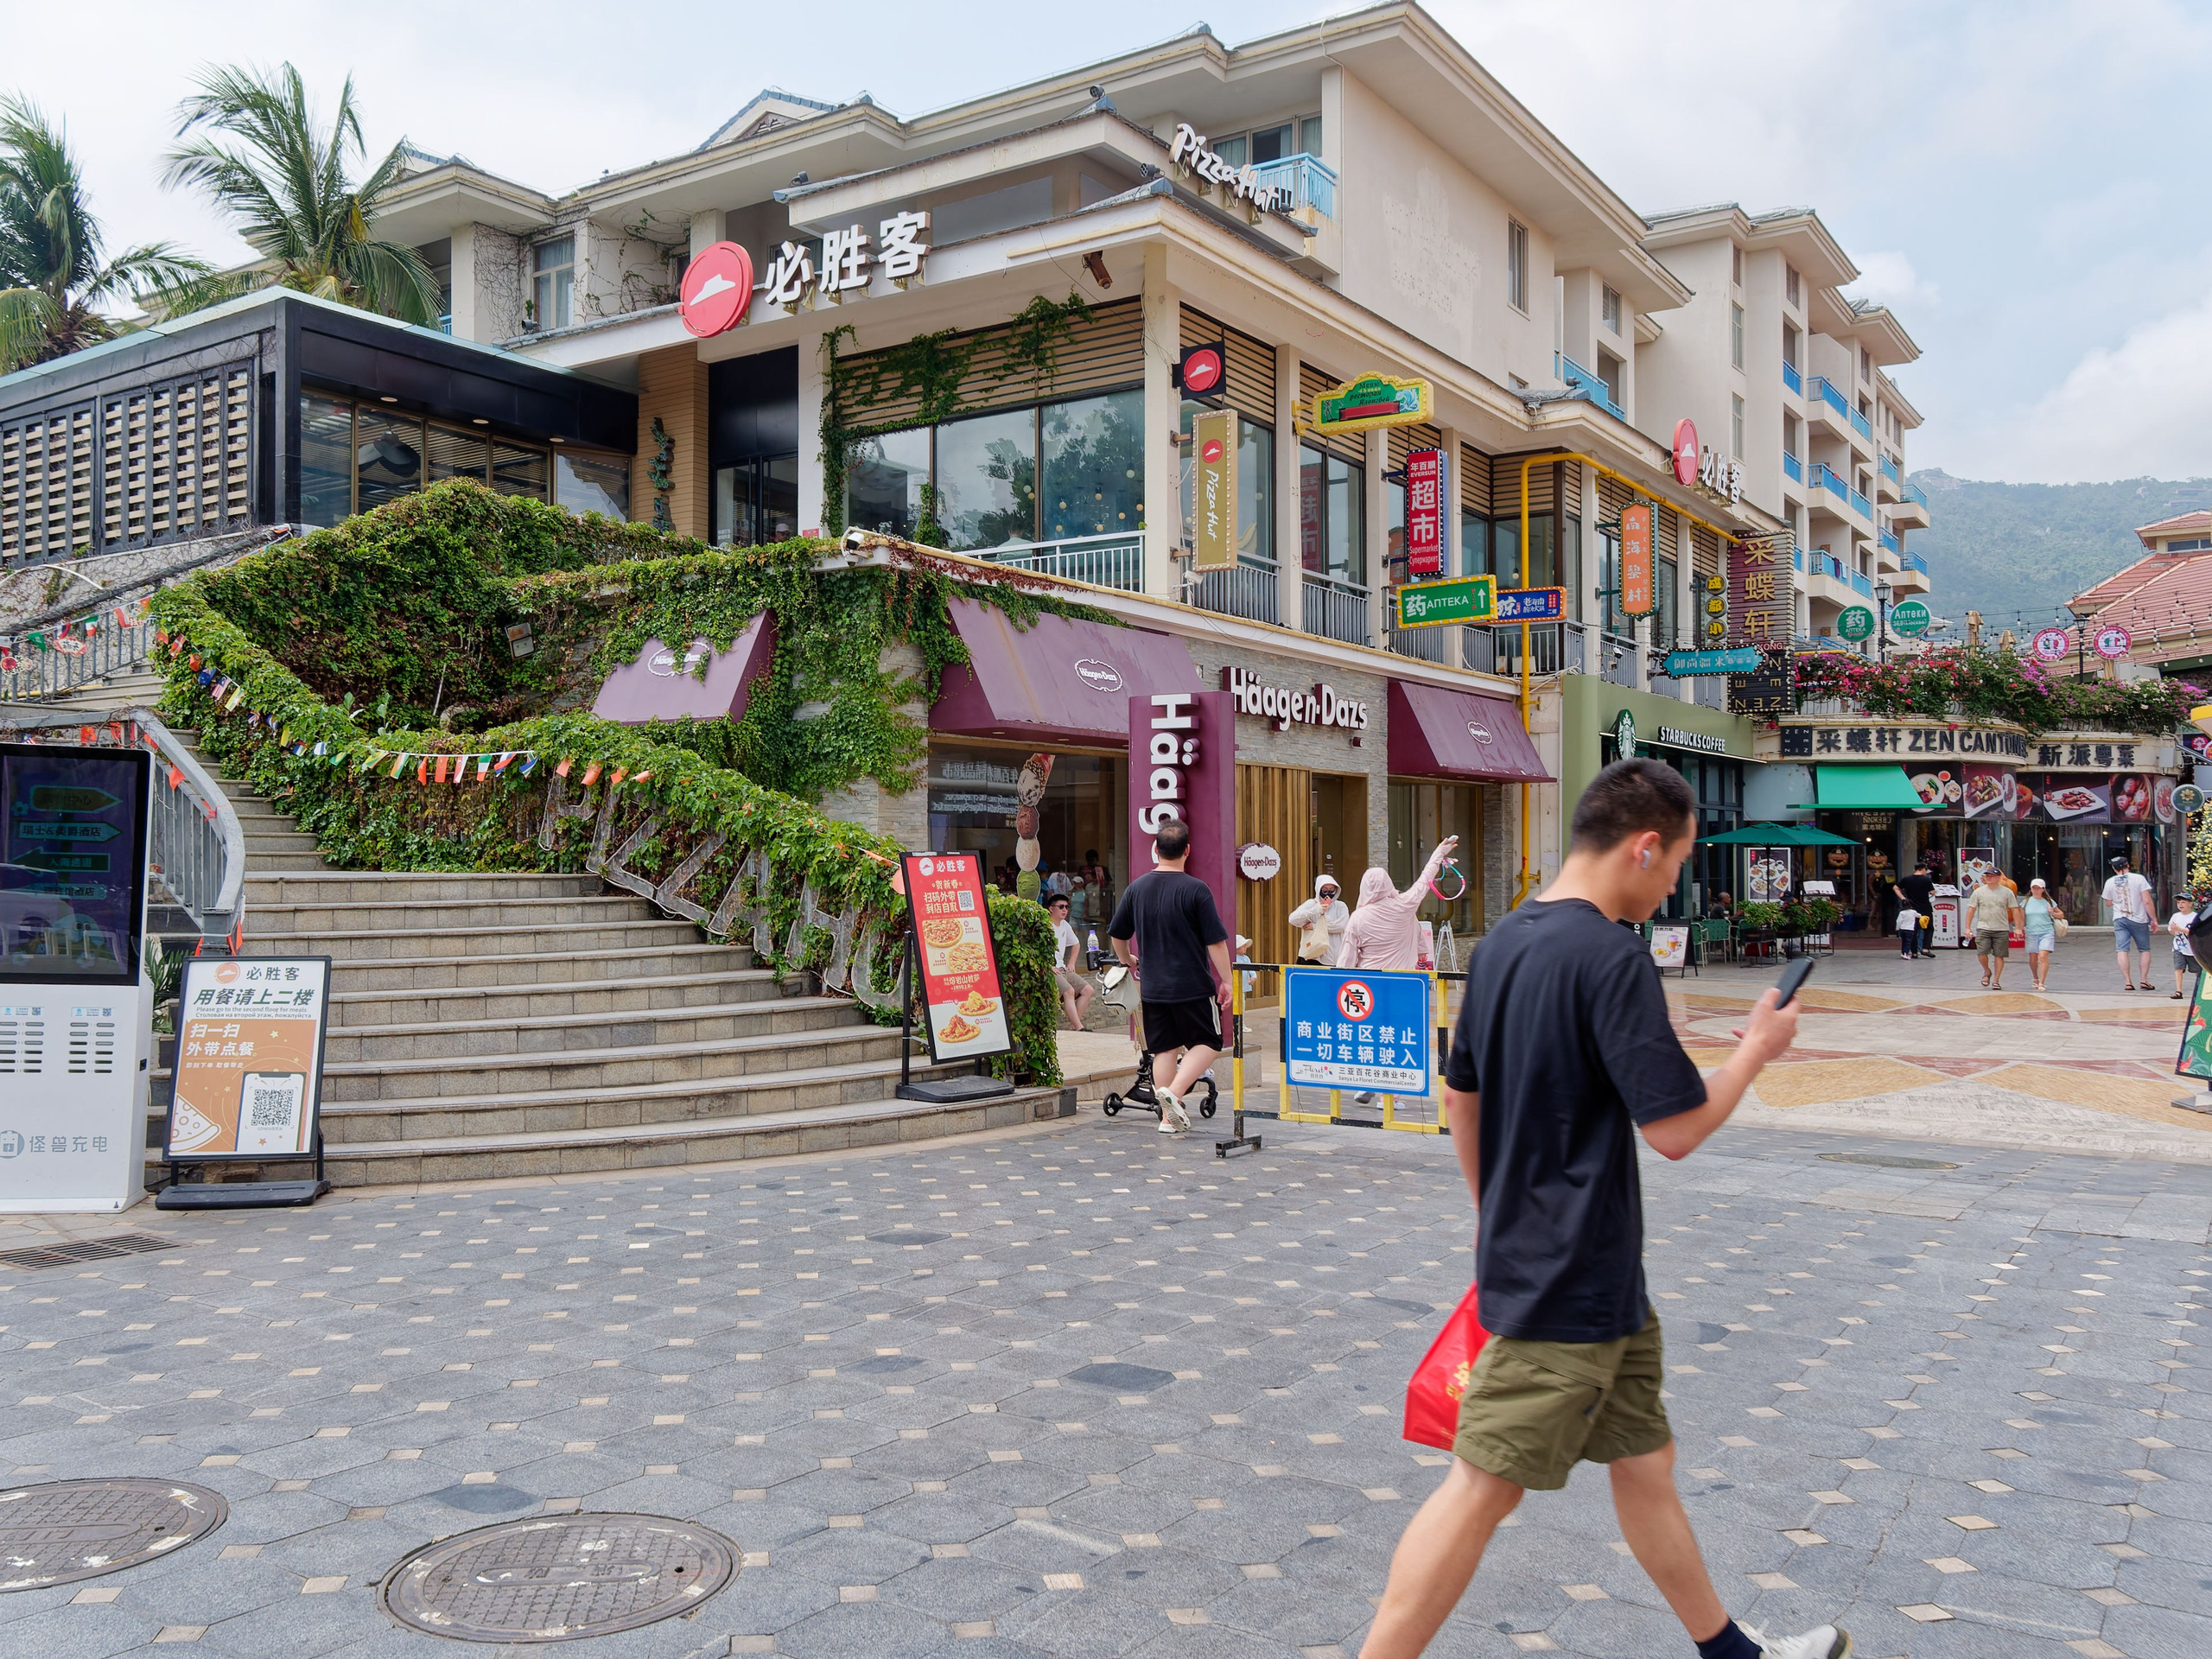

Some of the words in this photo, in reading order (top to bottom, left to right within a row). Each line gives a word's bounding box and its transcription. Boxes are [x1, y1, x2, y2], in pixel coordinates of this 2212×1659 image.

[1170, 123, 1236, 185] Pizza
[1235, 163, 1280, 213] Hut
[764, 211, 931, 305] 必胜客
[1350, 391, 1382, 401] ресторан
[1359, 396, 1390, 405] Ялонгбей
[1700, 445, 1741, 504] 必胜客
[1205, 468, 1220, 511] Pizza
[1411, 480, 1436, 543] 超市
[1207, 511, 1219, 543] Hut
[1409, 543, 1438, 555] Supermarket
[1626, 516, 1641, 602] 南海黎村
[1409, 555, 1438, 566] Супермаркет
[1744, 536, 1776, 639] 采蝶轩
[1404, 594, 1427, 617] 药
[1427, 594, 1469, 609] АПТЕКА
[1846, 609, 1866, 628] 药
[1894, 609, 1927, 620] Аптеки
[1229, 666, 1369, 731] Häagen-Dazs
[1659, 726, 1702, 749] STARBUCKS
[1701, 734, 1726, 752] COFFEE
[1817, 728, 1902, 753] 采蝶轩
[1909, 729, 1955, 752] ZEN
[2037, 744, 2135, 767] 新派粤菜
[1138, 692, 1200, 865] Häag
[936, 860, 966, 873] 必胜客
[1243, 855, 1278, 869] Häagen-Dazs
[935, 879, 959, 890] 贺新春
[924, 891, 957, 903] 扫码外带
[925, 902, 959, 914] 到店自取
[246, 967, 300, 981] 必胜客
[194, 988, 315, 1007] 用餐请上二楼
[1344, 988, 1366, 1014] 停
[189, 1023, 241, 1038] 扫一扫
[1297, 1020, 1417, 1046] 商业街区禁止
[186, 1041, 255, 1057] 外带点餐
[1296, 1042, 1418, 1067] 一切车辆驶入
[1338, 1066, 1417, 1081] 三亚百花谷商业中心
[29, 1135, 108, 1153] 怪兽充电
